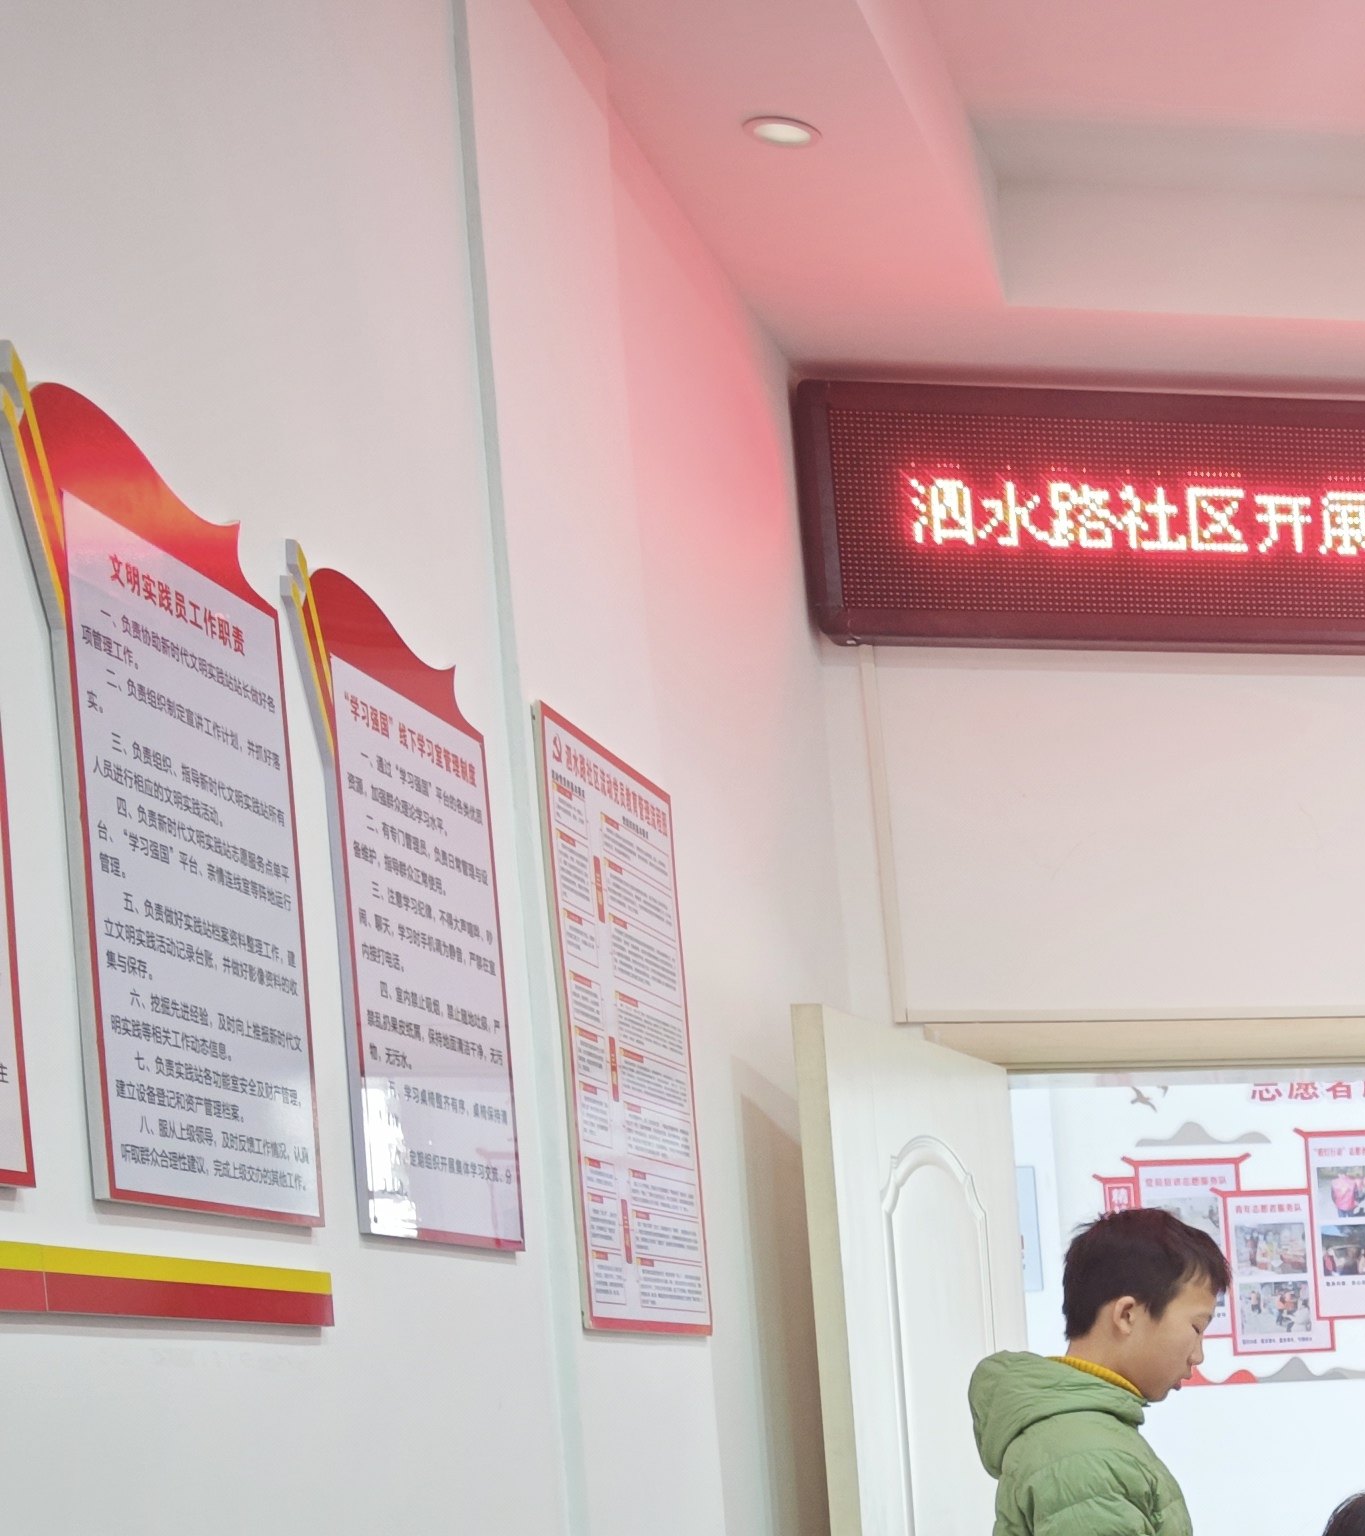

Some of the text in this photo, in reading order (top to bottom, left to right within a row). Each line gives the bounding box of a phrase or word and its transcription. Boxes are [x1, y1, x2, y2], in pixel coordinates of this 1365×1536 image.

[109, 554, 245, 656] 文明实践员工作职责
[80, 622, 139, 671] 项管理工作。
[86, 688, 104, 715] 实。
[91, 753, 223, 828] 人员进行相应的文明实践活动。
[98, 851, 126, 879] 管理。
[105, 949, 153, 981] 集与保存。
[110, 1014, 231, 1061] 明实践等相关工作动态信息。
